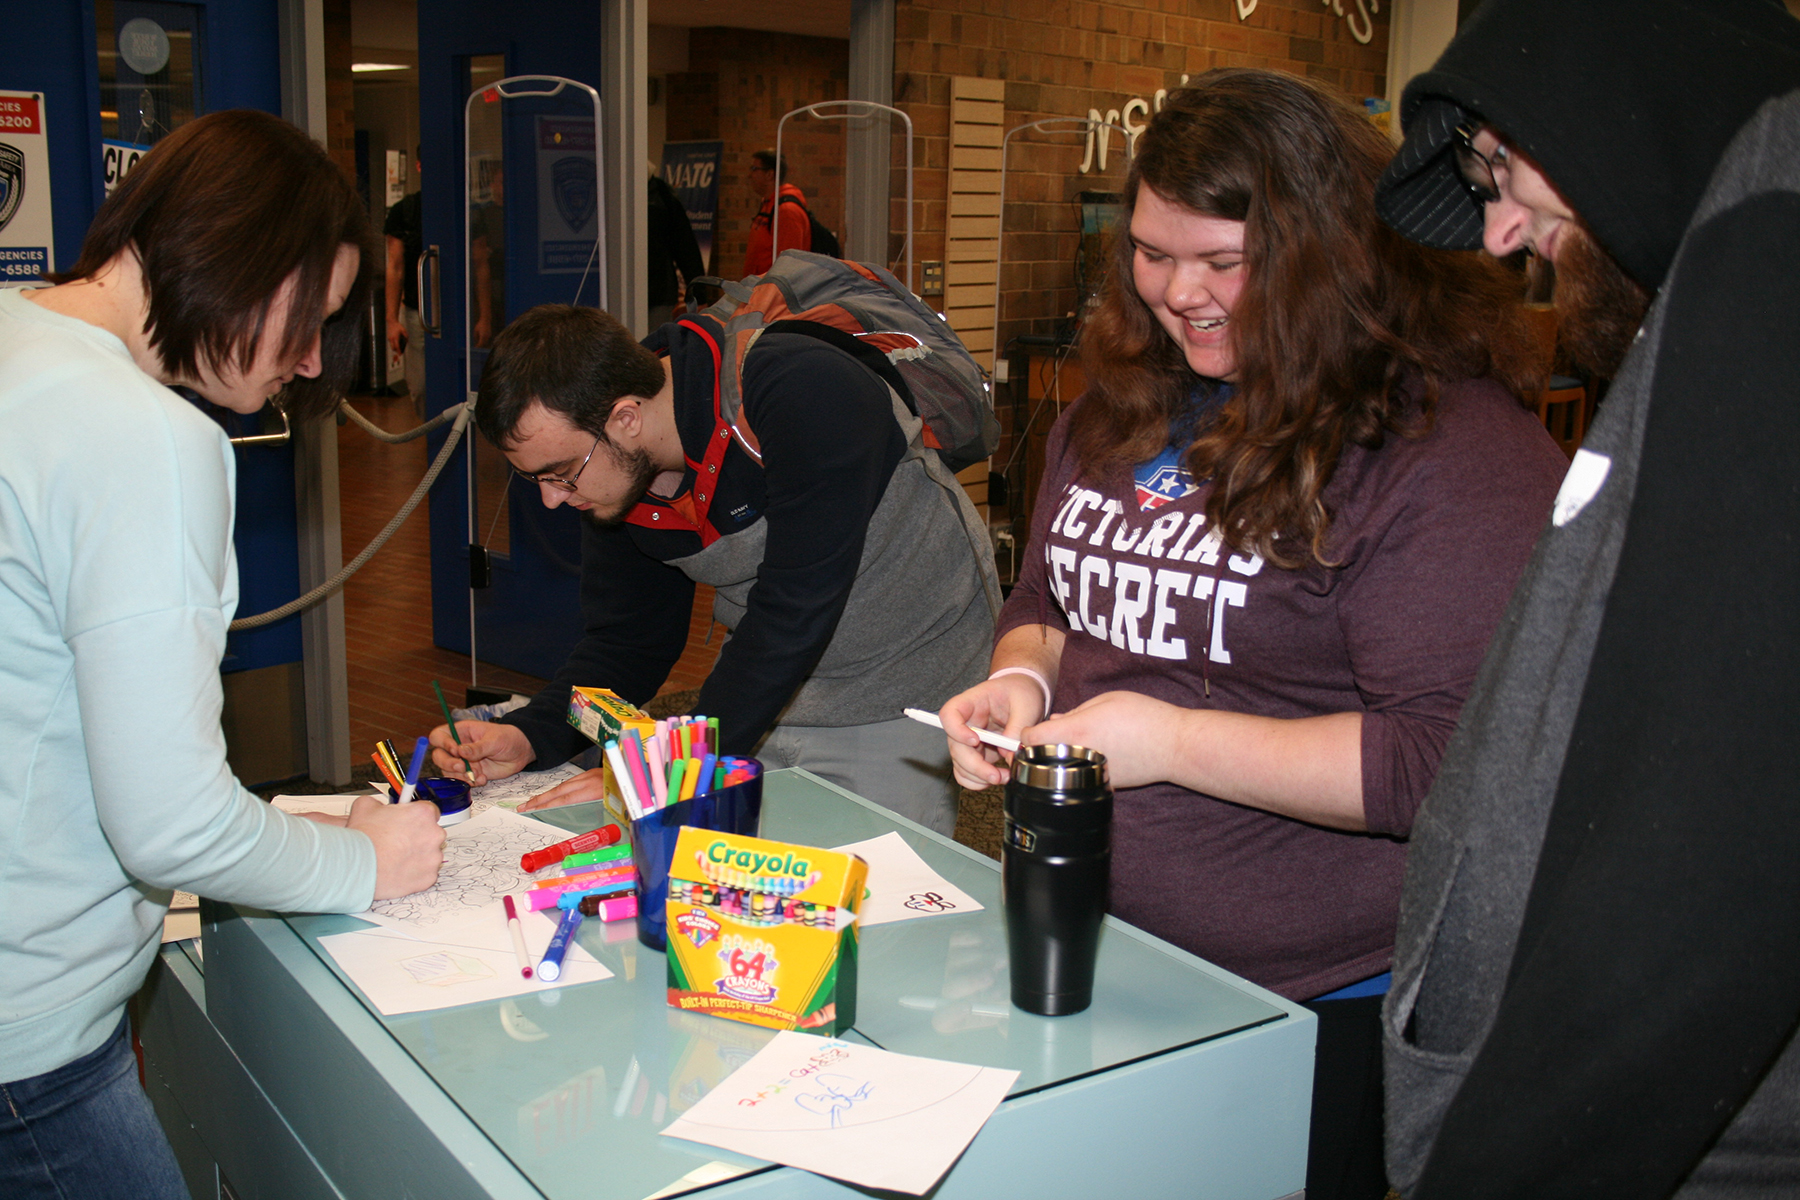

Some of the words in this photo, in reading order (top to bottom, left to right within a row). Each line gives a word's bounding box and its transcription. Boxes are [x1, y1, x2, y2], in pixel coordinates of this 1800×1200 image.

[664, 161, 715, 189] MATC
[1045, 542, 1247, 664] ECRET
[708, 841, 809, 877] Crayola
[730, 948, 766, 980] 64
[725, 976, 770, 995] CRAYONS
[754, 1004, 797, 1022] SHARPENER
